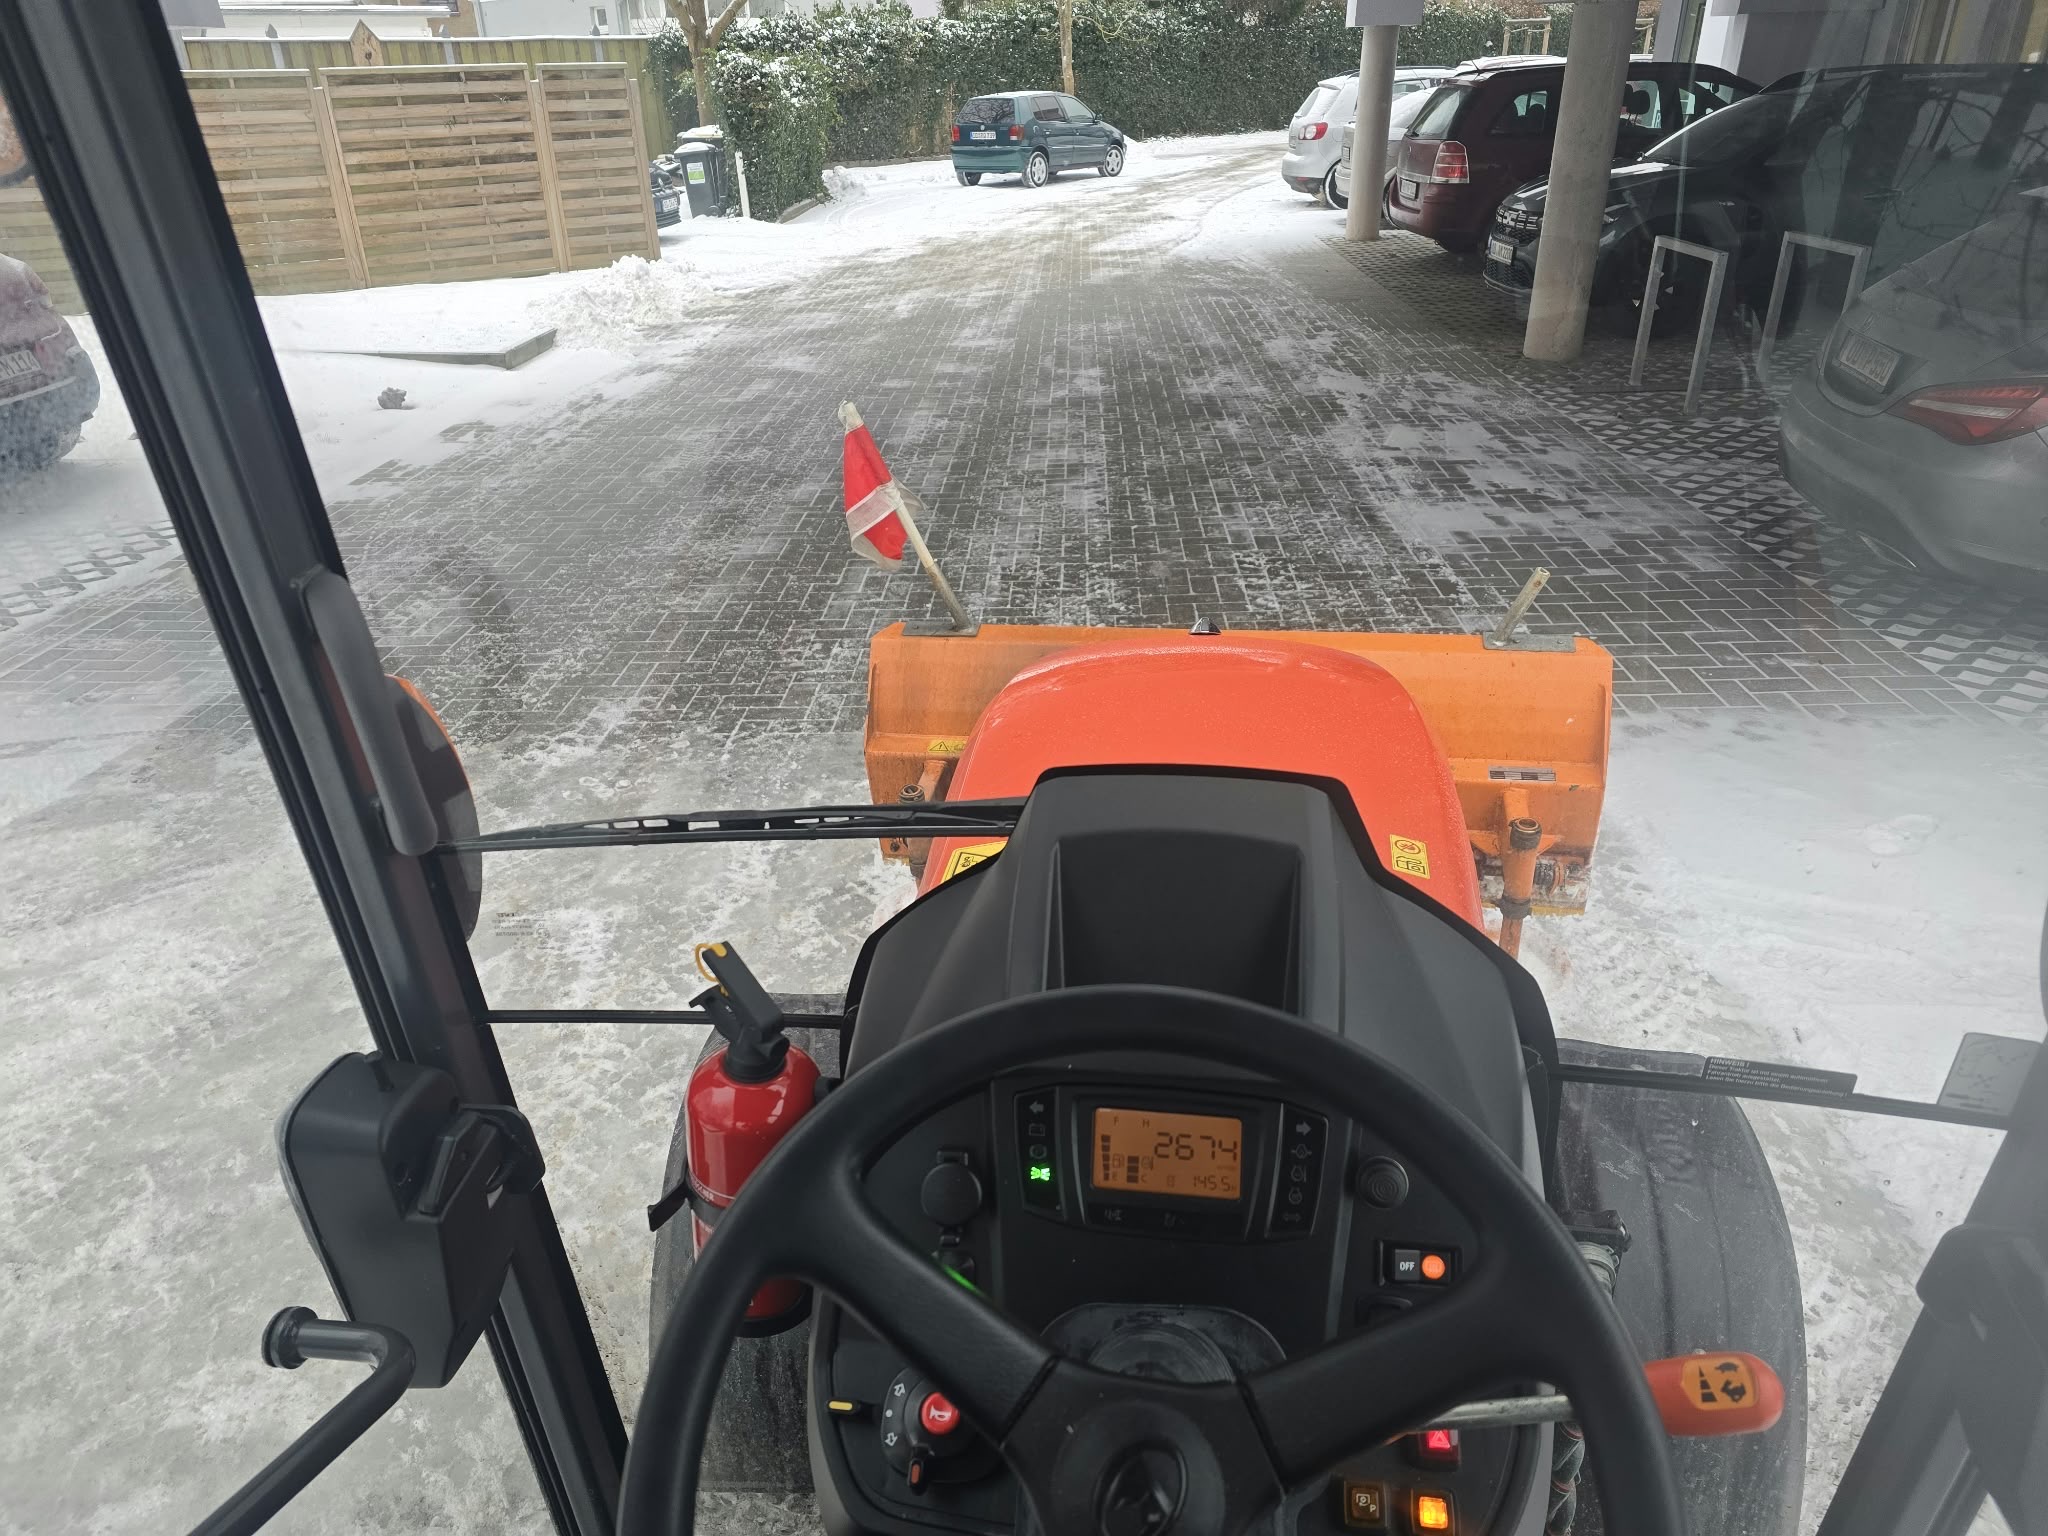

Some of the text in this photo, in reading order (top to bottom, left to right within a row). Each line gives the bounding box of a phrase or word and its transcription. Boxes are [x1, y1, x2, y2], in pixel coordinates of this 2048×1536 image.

[1113, 1116, 1119, 1126] F
[1142, 1119, 1150, 1129] H
[1154, 1131, 1238, 1161] 2674
[1399, 1261, 1415, 1272] OFF
[1369, 1504, 1377, 1513] P
